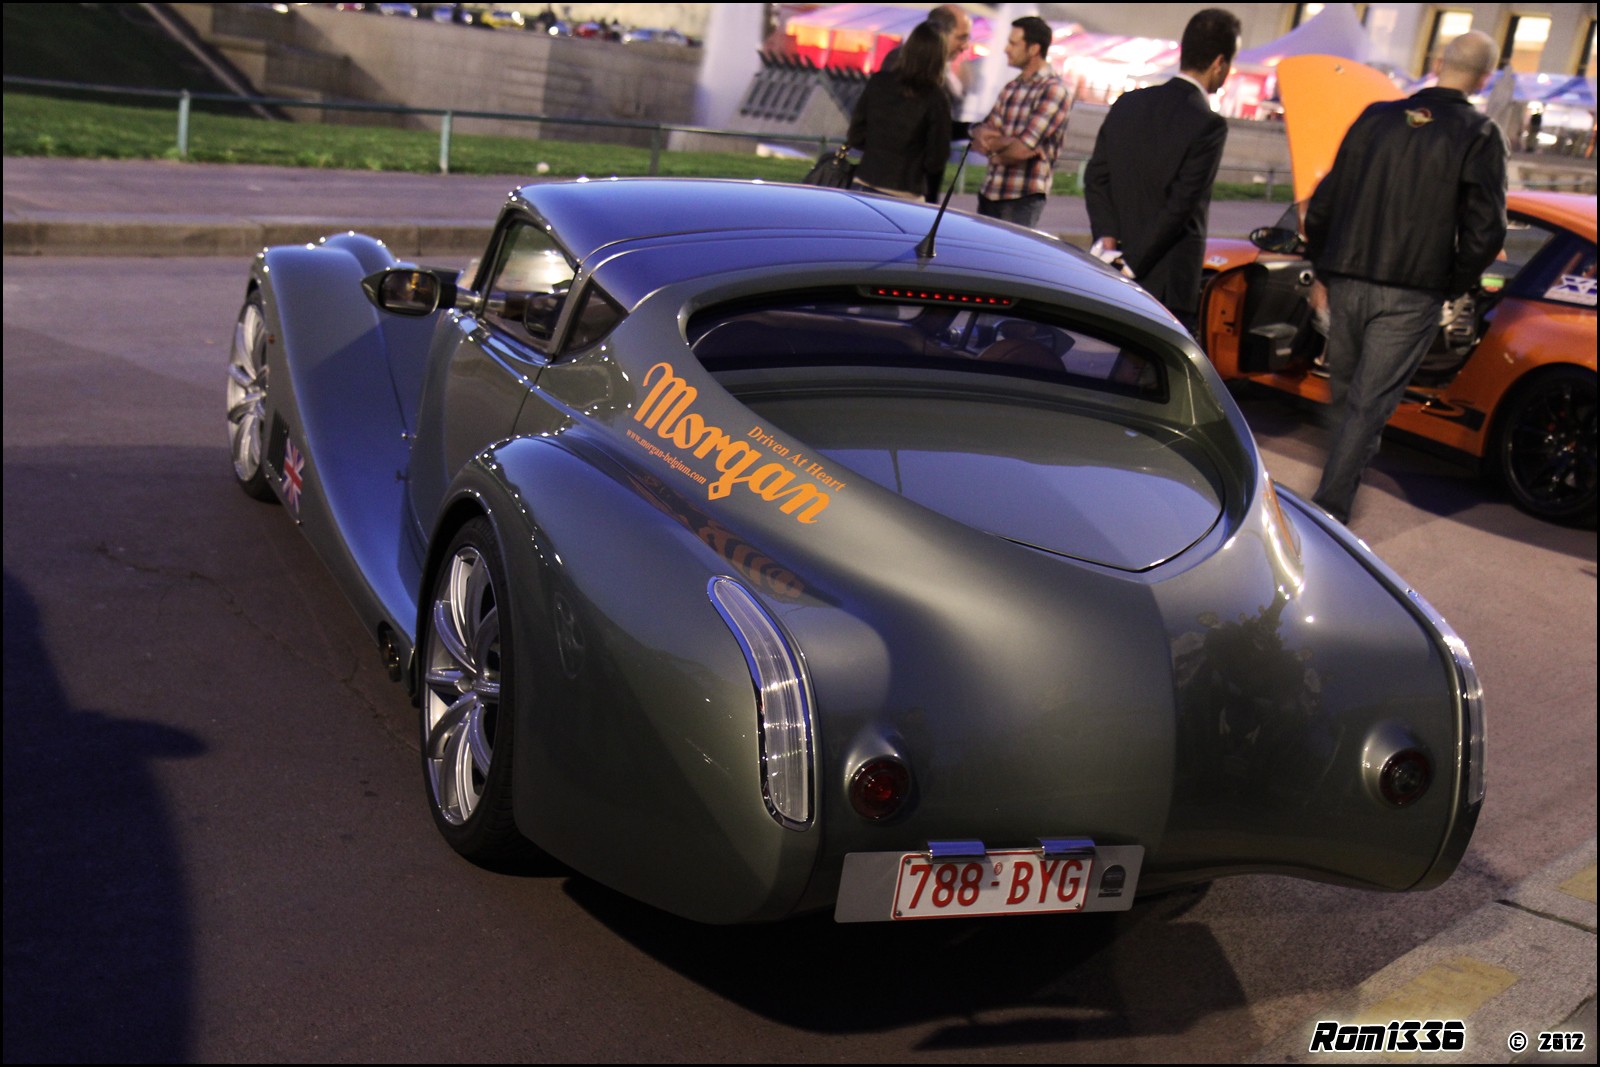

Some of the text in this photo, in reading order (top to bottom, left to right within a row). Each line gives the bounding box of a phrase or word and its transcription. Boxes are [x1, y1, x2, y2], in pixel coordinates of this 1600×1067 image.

[626, 429, 707, 485] www.morgan-belgium.com
[633, 362, 831, 524] Morgan
[747, 425, 847, 492] Driven At Heart
